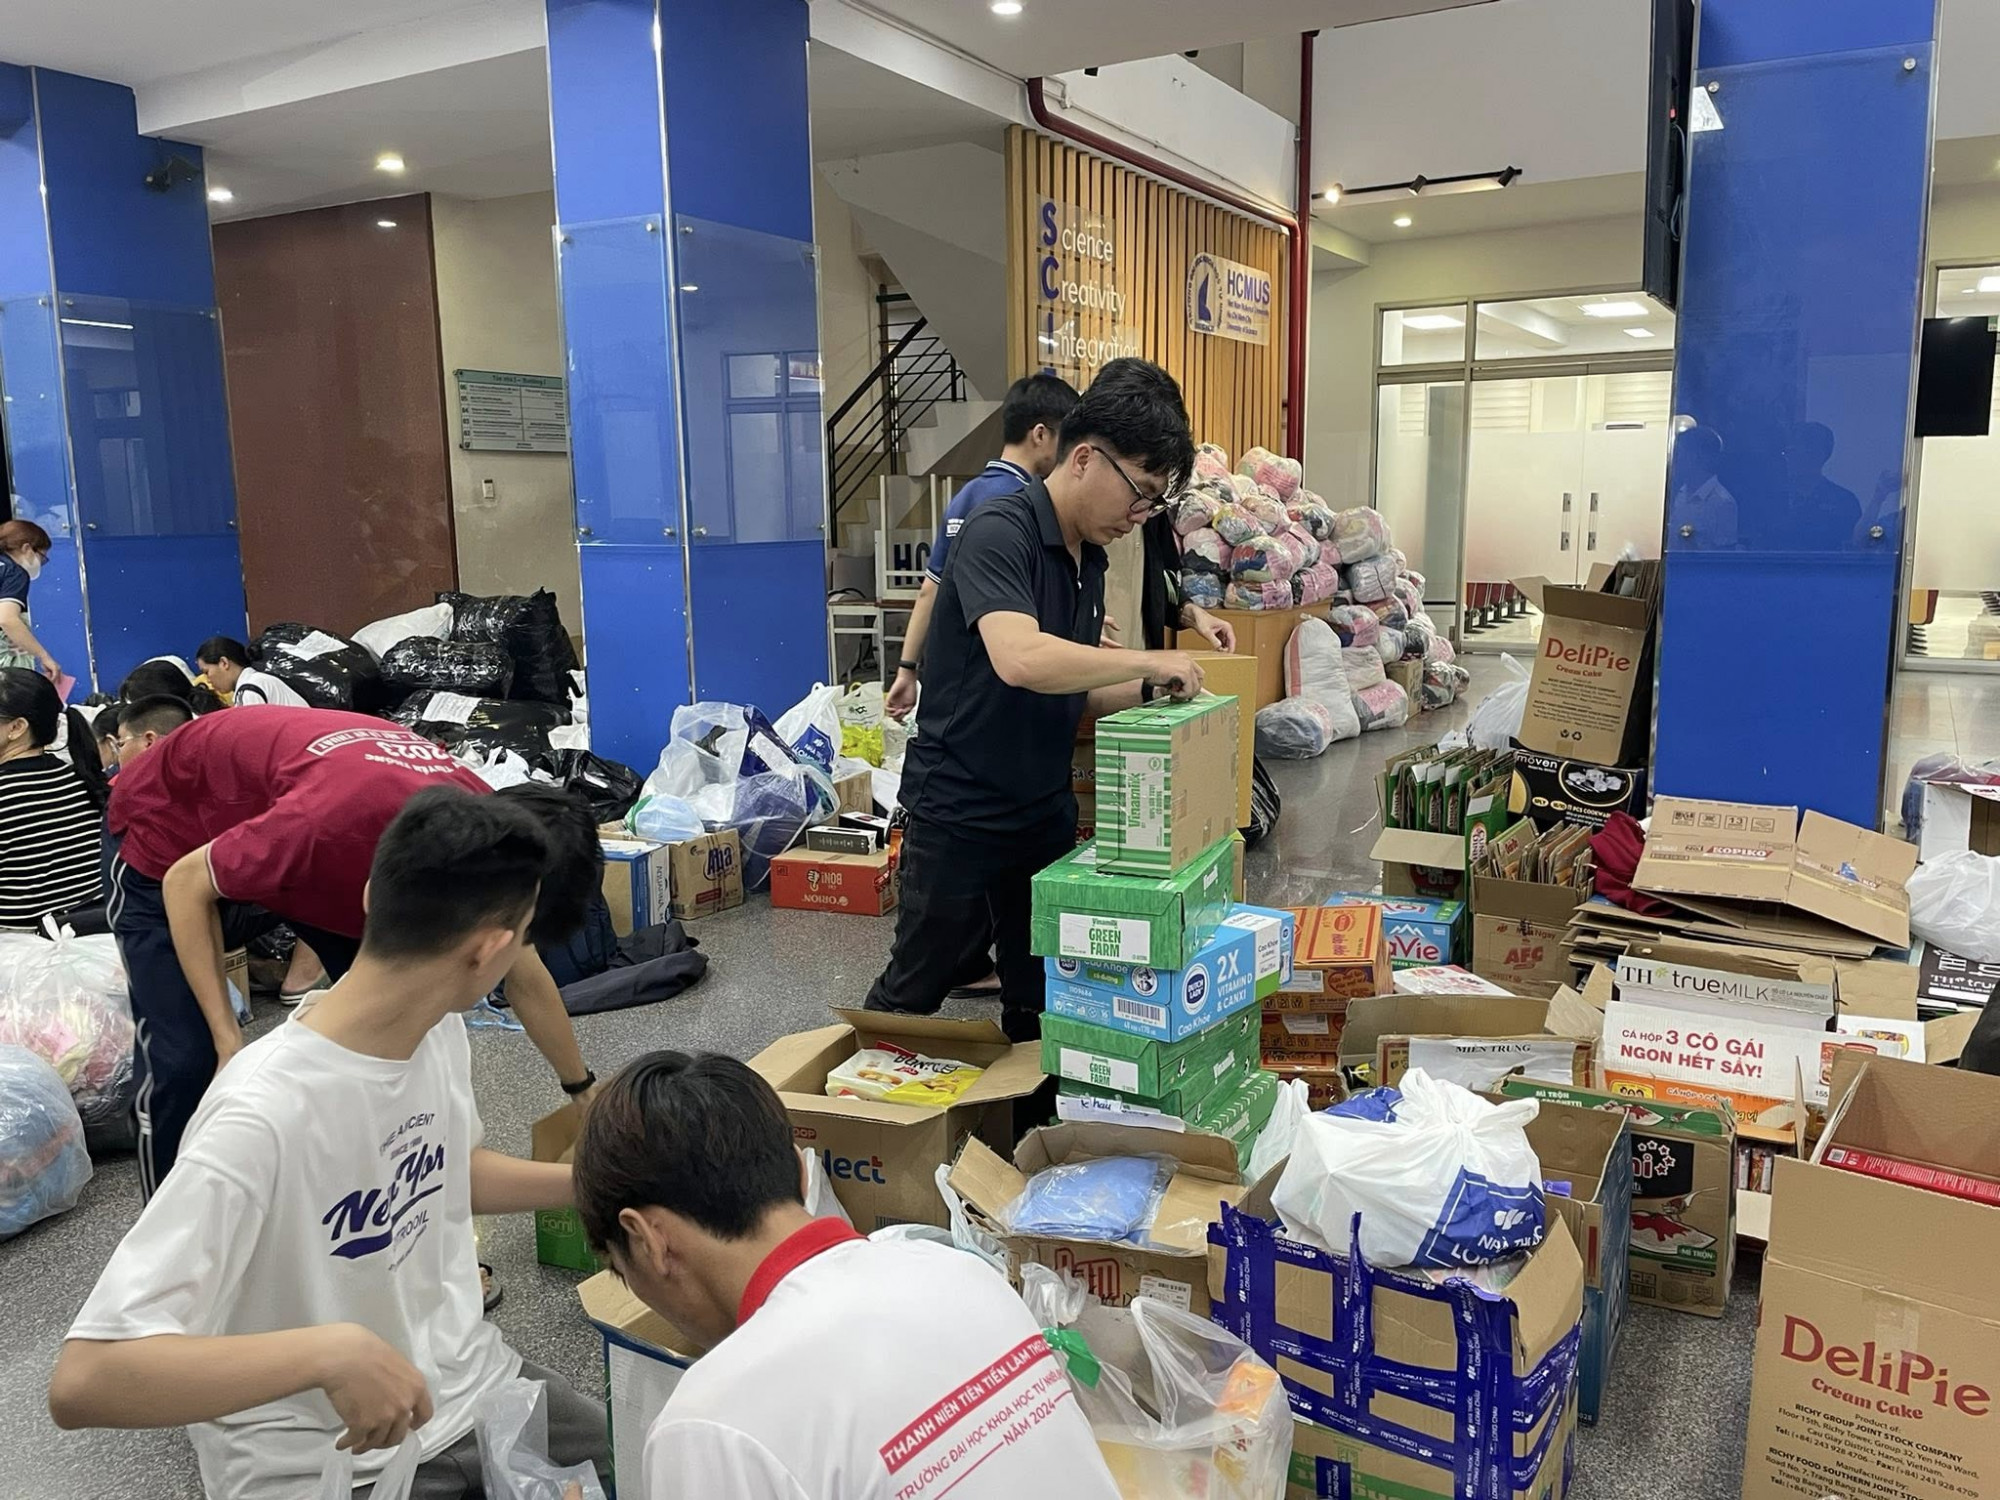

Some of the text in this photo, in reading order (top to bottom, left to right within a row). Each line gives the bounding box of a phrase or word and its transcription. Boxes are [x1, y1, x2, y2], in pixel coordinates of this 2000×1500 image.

[1227, 268, 1270, 305] HCMUS
[1545, 637, 1631, 672] DeliPie
[376, 741, 449, 761] 2023
[1128, 773, 1141, 828] Vinamilk
[1712, 846, 1767, 857] KOPIKO
[804, 894, 836, 905] ORION
[1089, 928, 1121, 944] GREEN
[1389, 935, 1439, 961] aVie
[1091, 943, 1120, 957] FARM
[1504, 946, 1544, 965] AFC
[1217, 948, 1239, 983] 2X
[1621, 965, 1653, 985] TH
[1217, 975, 1247, 998] VITAMIN
[1223, 989, 1246, 1009] CANXI
[1490, 1044, 1531, 1053] TRUNG
[1622, 1028, 1763, 1059] CÁ HỘP 3 CÔ GÁI
[1090, 1062, 1111, 1076] GREEN
[1620, 1044, 1672, 1064] NGON
[1678, 1050, 1715, 1071] HẾT
[1091, 1073, 1110, 1086] FARM
[824, 1148, 885, 1184] lect
[1780, 1314, 1991, 1416] DeliPie
[884, 1418, 937, 1466] THANH
[933, 1398, 960, 1427] NIÊN
[957, 1383, 985, 1407] TIÊN
[981, 1366, 1009, 1389] TIẾN
[1005, 1348, 1031, 1373] LÀM
[1812, 1377, 1924, 1420] Cream Cake
[1002, 1398, 1057, 1447] NĂM 2024
[1795, 1404, 1963, 1463] RICHY GROUP JOINT STOCK COMPANY
[1855, 1413, 1888, 1429] Product
[895, 1456, 950, 1500] TRƯỜNG
[948, 1439, 969, 1463] ĐẠI
[965, 1425, 988, 1449] HỌC
[986, 1406, 1014, 1432] KHOA
[1014, 1390, 1035, 1412] HỌC
[1778, 1407, 1799, 1419] Floor
[1822, 1422, 1845, 1436] Richy
[1874, 1440, 1901, 1454] Group
[1917, 1453, 1932, 1464] Yen
[1935, 1460, 1952, 1470] Hoa
[1765, 1455, 1785, 1467] Road
[1811, 1471, 1833, 1485] Trang
[1834, 1478, 1856, 1493] Bang
[1769, 1447, 1898, 1497] RICHY FOOD SOUTHERN JOINT
[1775, 1425, 1790, 1436] Tel:
[1814, 1439, 1829, 1449] 243
[1830, 1444, 1846, 1455] 928
[1847, 1450, 1868, 1463] 4706
[1876, 1460, 1894, 1471] Fax:
[1896, 1466, 1918, 1479] (+84)
[1920, 1475, 1936, 1485] 243
[1939, 1480, 1955, 1491] 928
[1956, 1486, 1979, 1498] 4709
[1836, 1461, 1895, 1487] Manufactured
[1778, 1469, 1800, 1483] Trang
[1802, 1477, 1823, 1492] Bang
